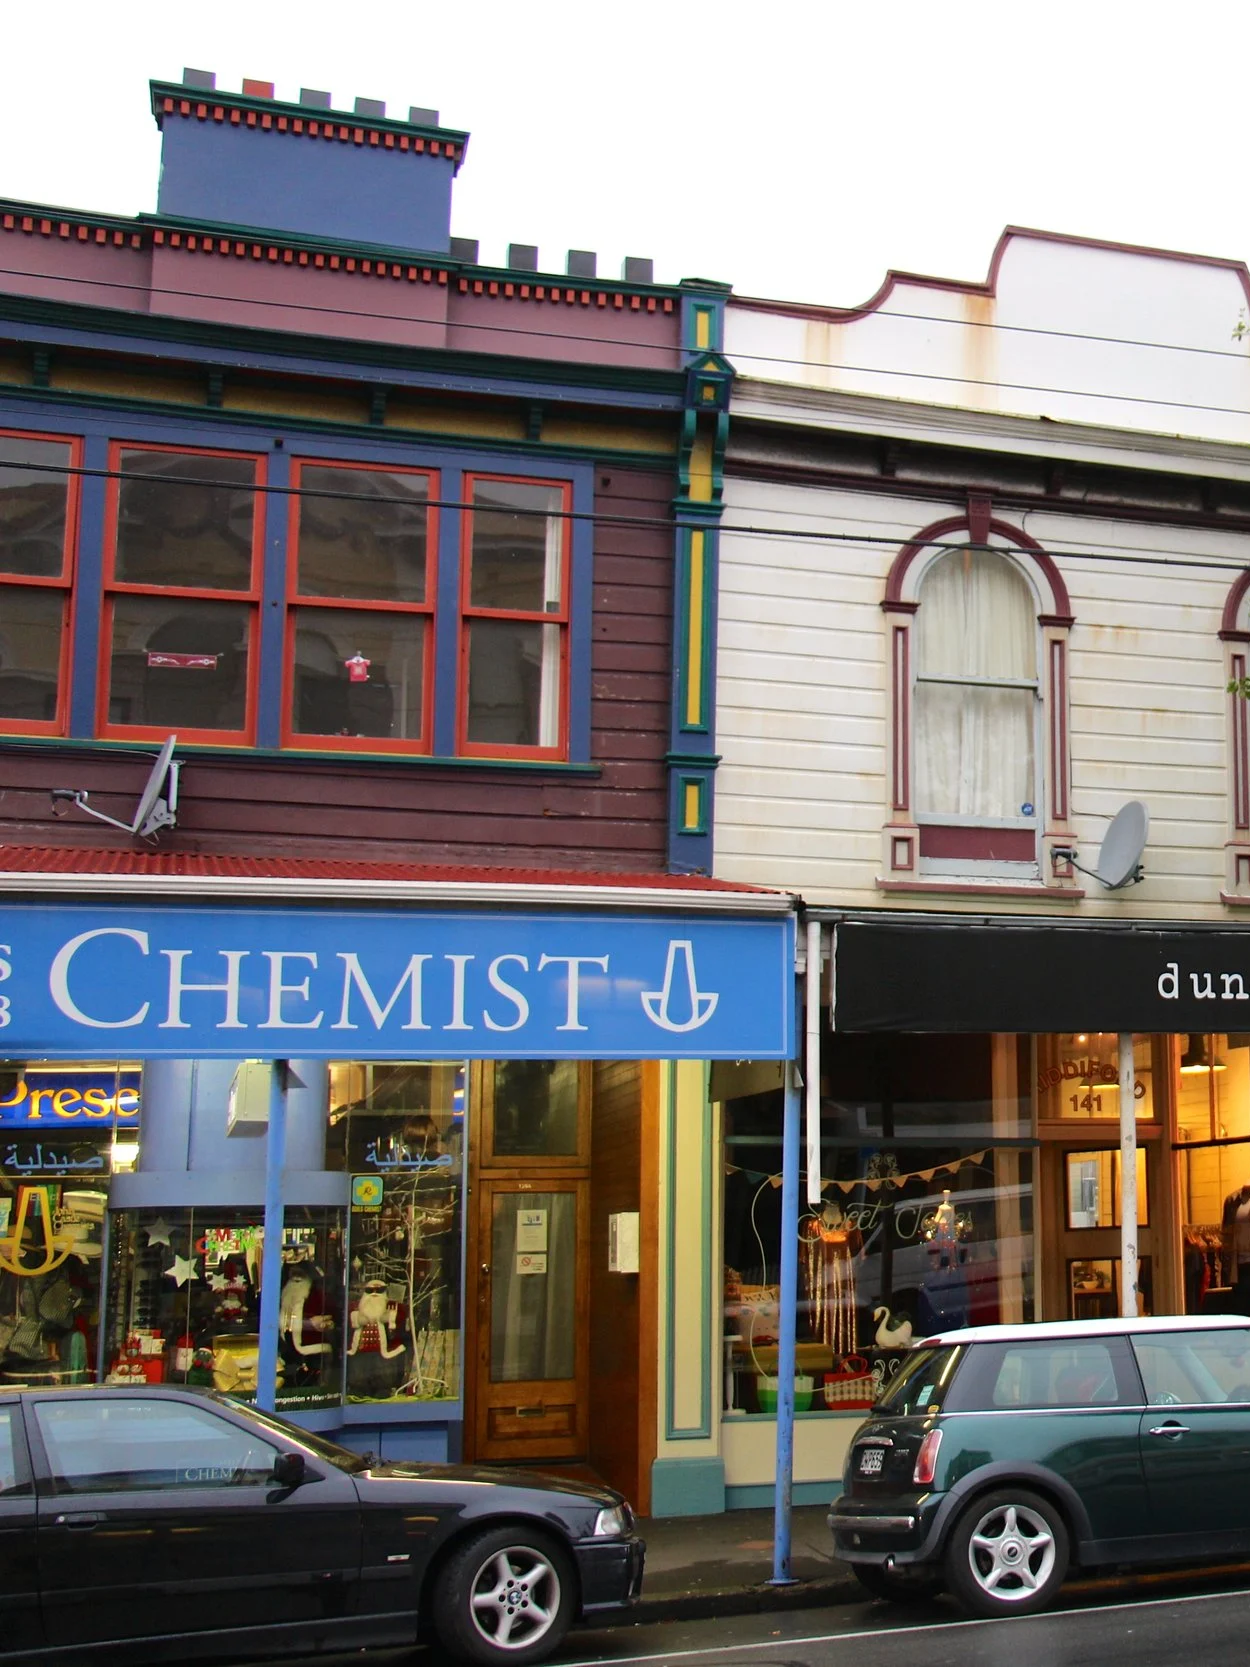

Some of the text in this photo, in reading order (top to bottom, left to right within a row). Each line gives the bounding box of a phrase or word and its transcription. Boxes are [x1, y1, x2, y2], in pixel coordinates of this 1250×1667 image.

[49, 927, 609, 1032] CHEMIST
[1038, 1060, 1147, 1099] IDDIFOD
[1069, 1094, 1102, 1112] 141
[4, 1143, 104, 1176] صيدلية
[274, 1394, 305, 1405] ongestion
